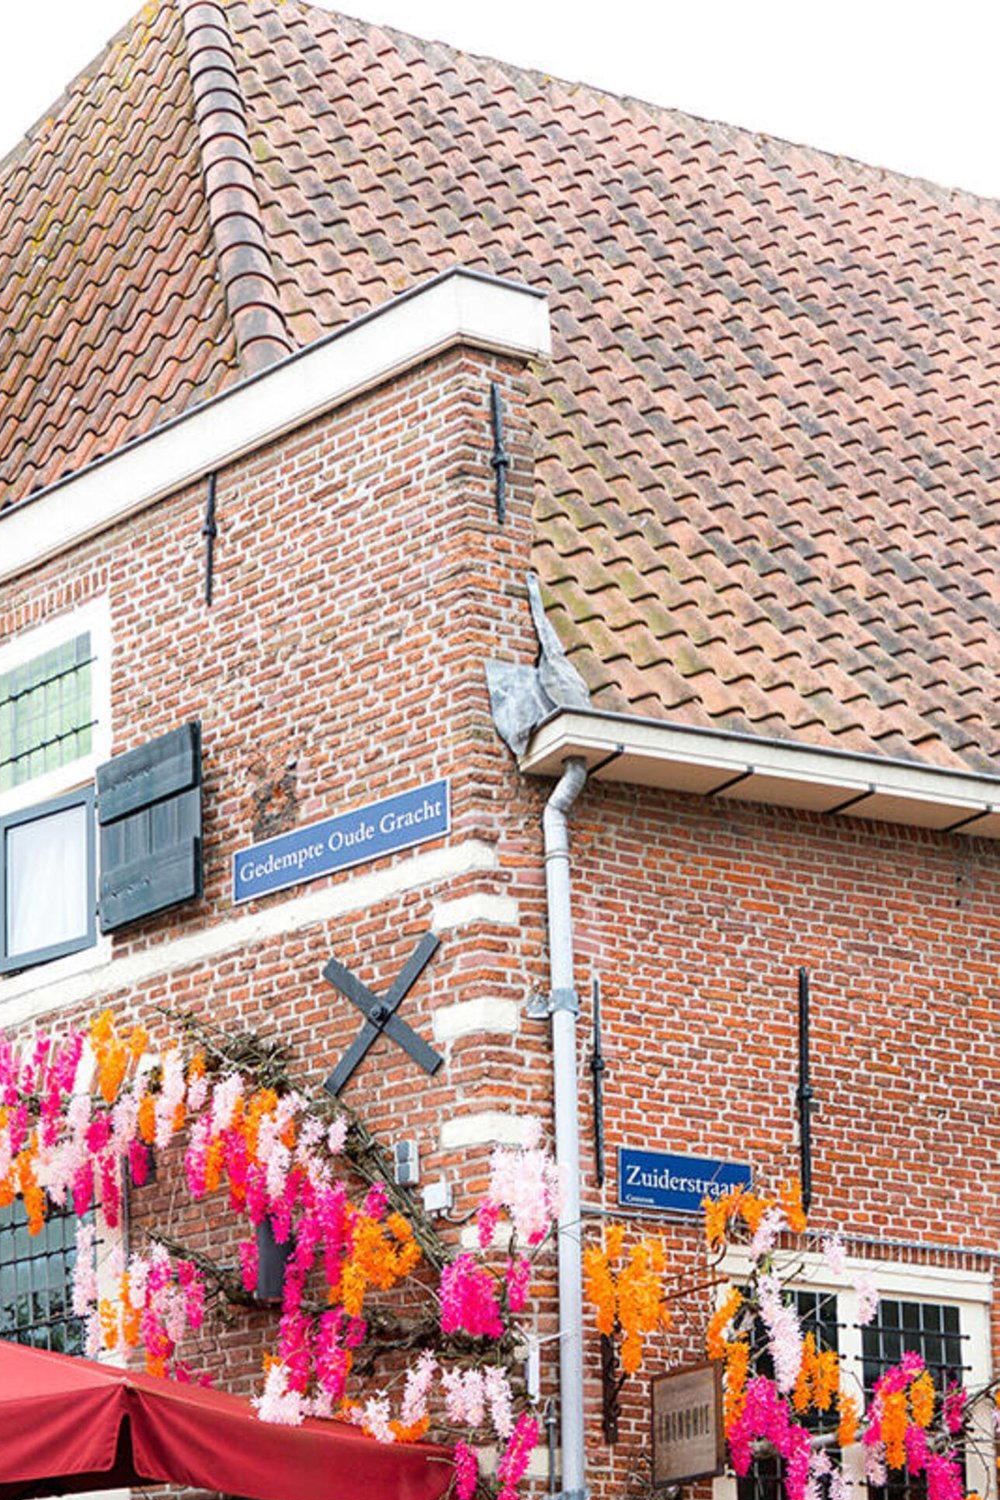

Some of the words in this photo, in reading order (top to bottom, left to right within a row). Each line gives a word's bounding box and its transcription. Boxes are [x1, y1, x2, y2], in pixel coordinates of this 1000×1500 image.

[239, 842, 324, 882] Gedempte
[327, 821, 375, 851] Oude
[379, 800, 443, 834] Gracht
